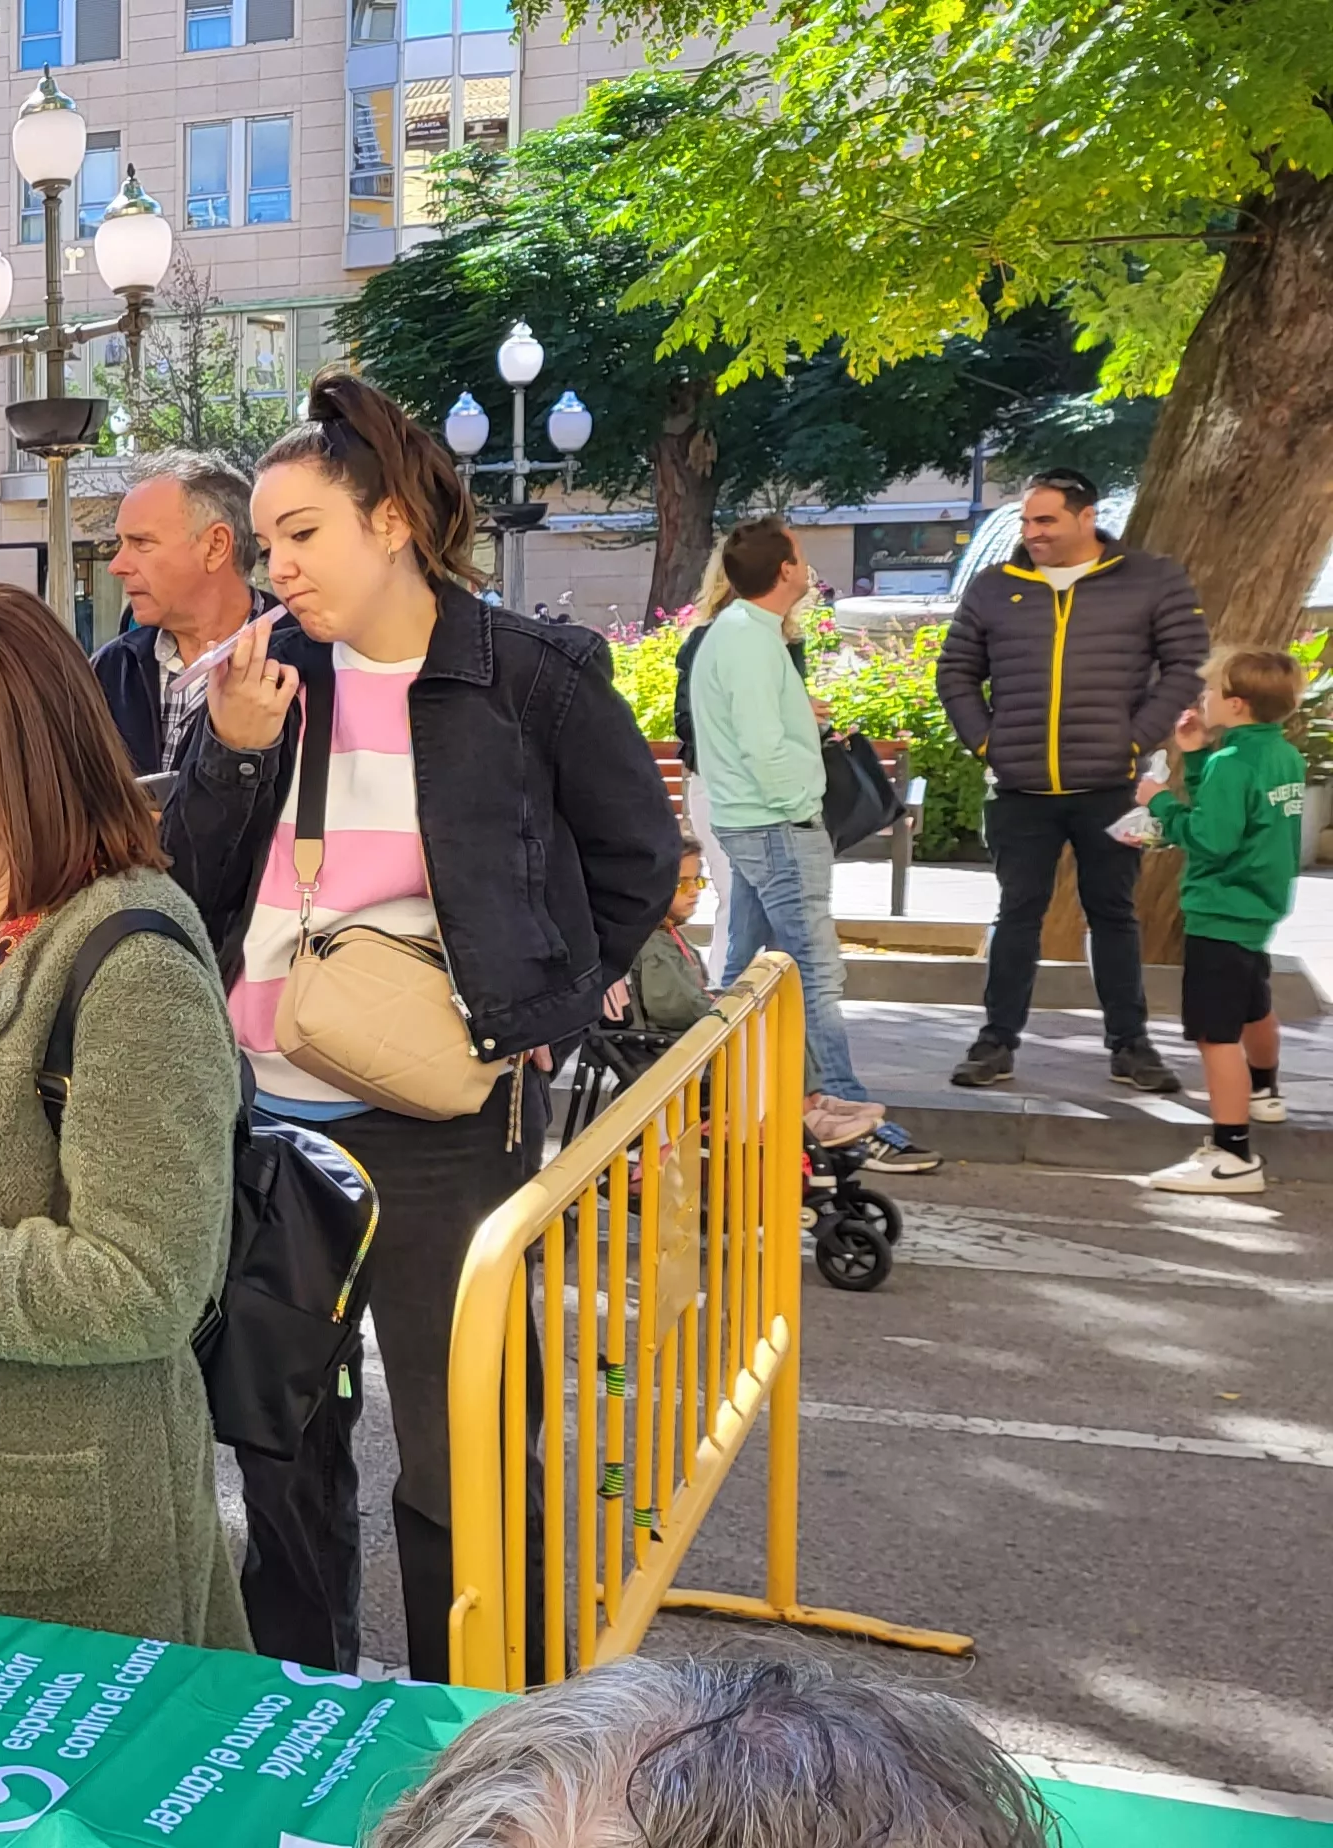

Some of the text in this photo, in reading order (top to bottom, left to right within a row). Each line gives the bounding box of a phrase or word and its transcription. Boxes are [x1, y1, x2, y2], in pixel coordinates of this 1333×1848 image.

[2, 1673, 86, 1751] española
[58, 1638, 171, 1760] contra el cánce
[257, 1699, 346, 1779] española
[301, 1698, 396, 1808] asociación
[143, 1694, 292, 1835] contra el cáncer
